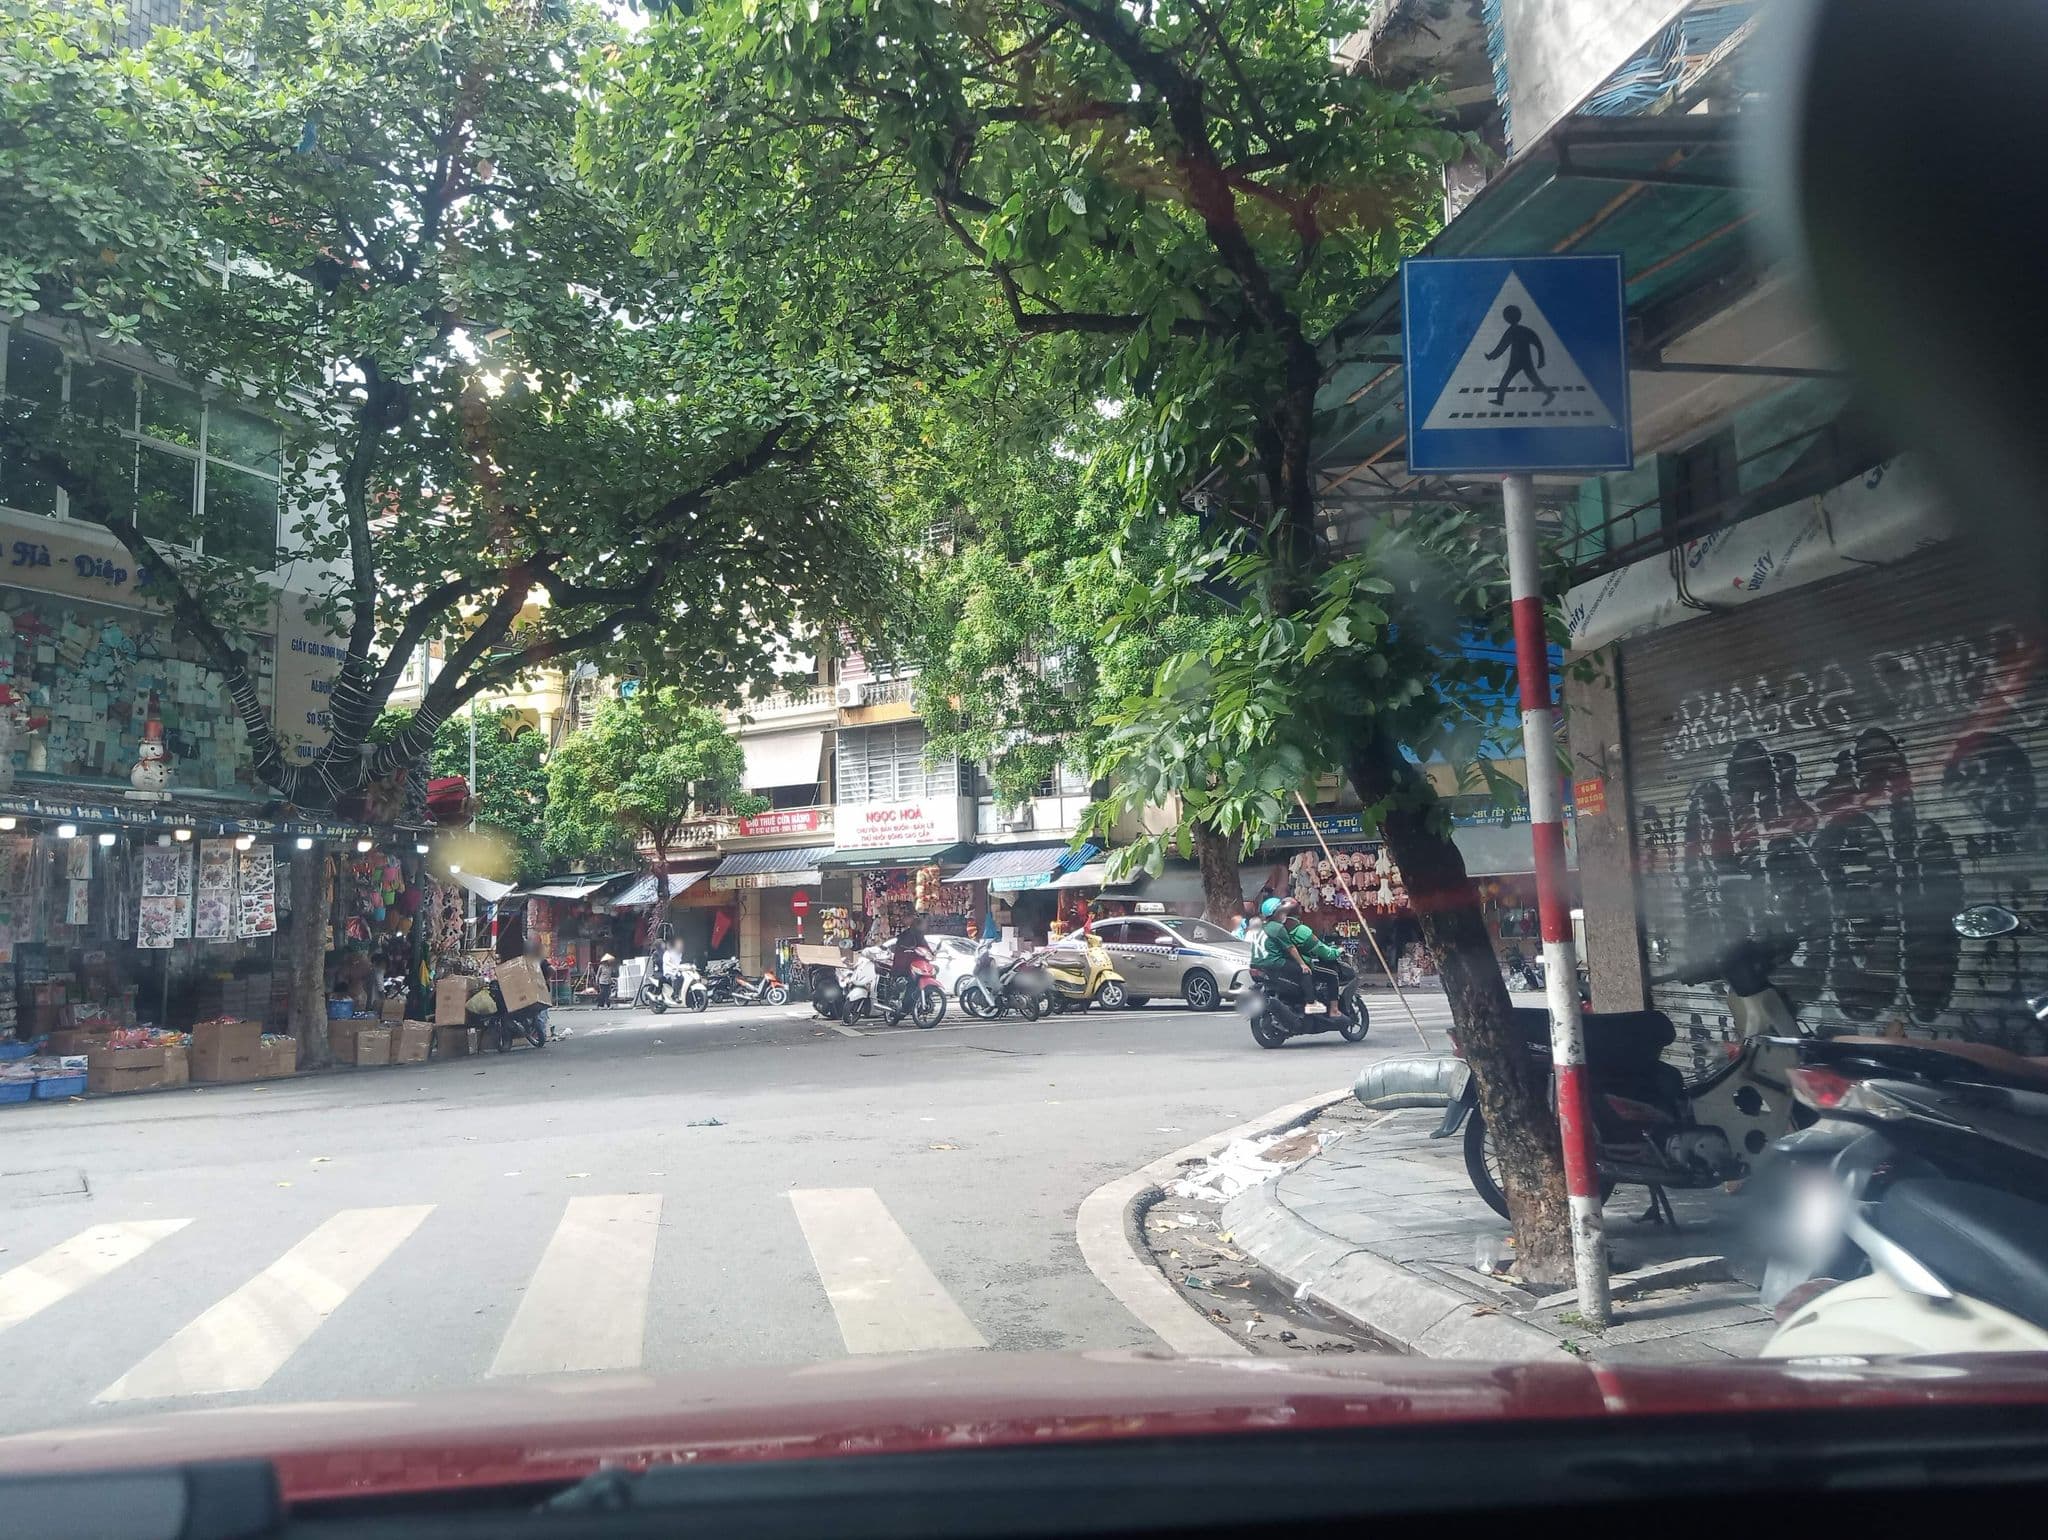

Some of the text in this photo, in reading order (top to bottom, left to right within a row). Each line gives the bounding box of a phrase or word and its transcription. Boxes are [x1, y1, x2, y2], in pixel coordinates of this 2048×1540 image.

[74, 554, 128, 587] Diệp
[1567, 602, 1585, 639] enify
[760, 815, 776, 826] THUÊ
